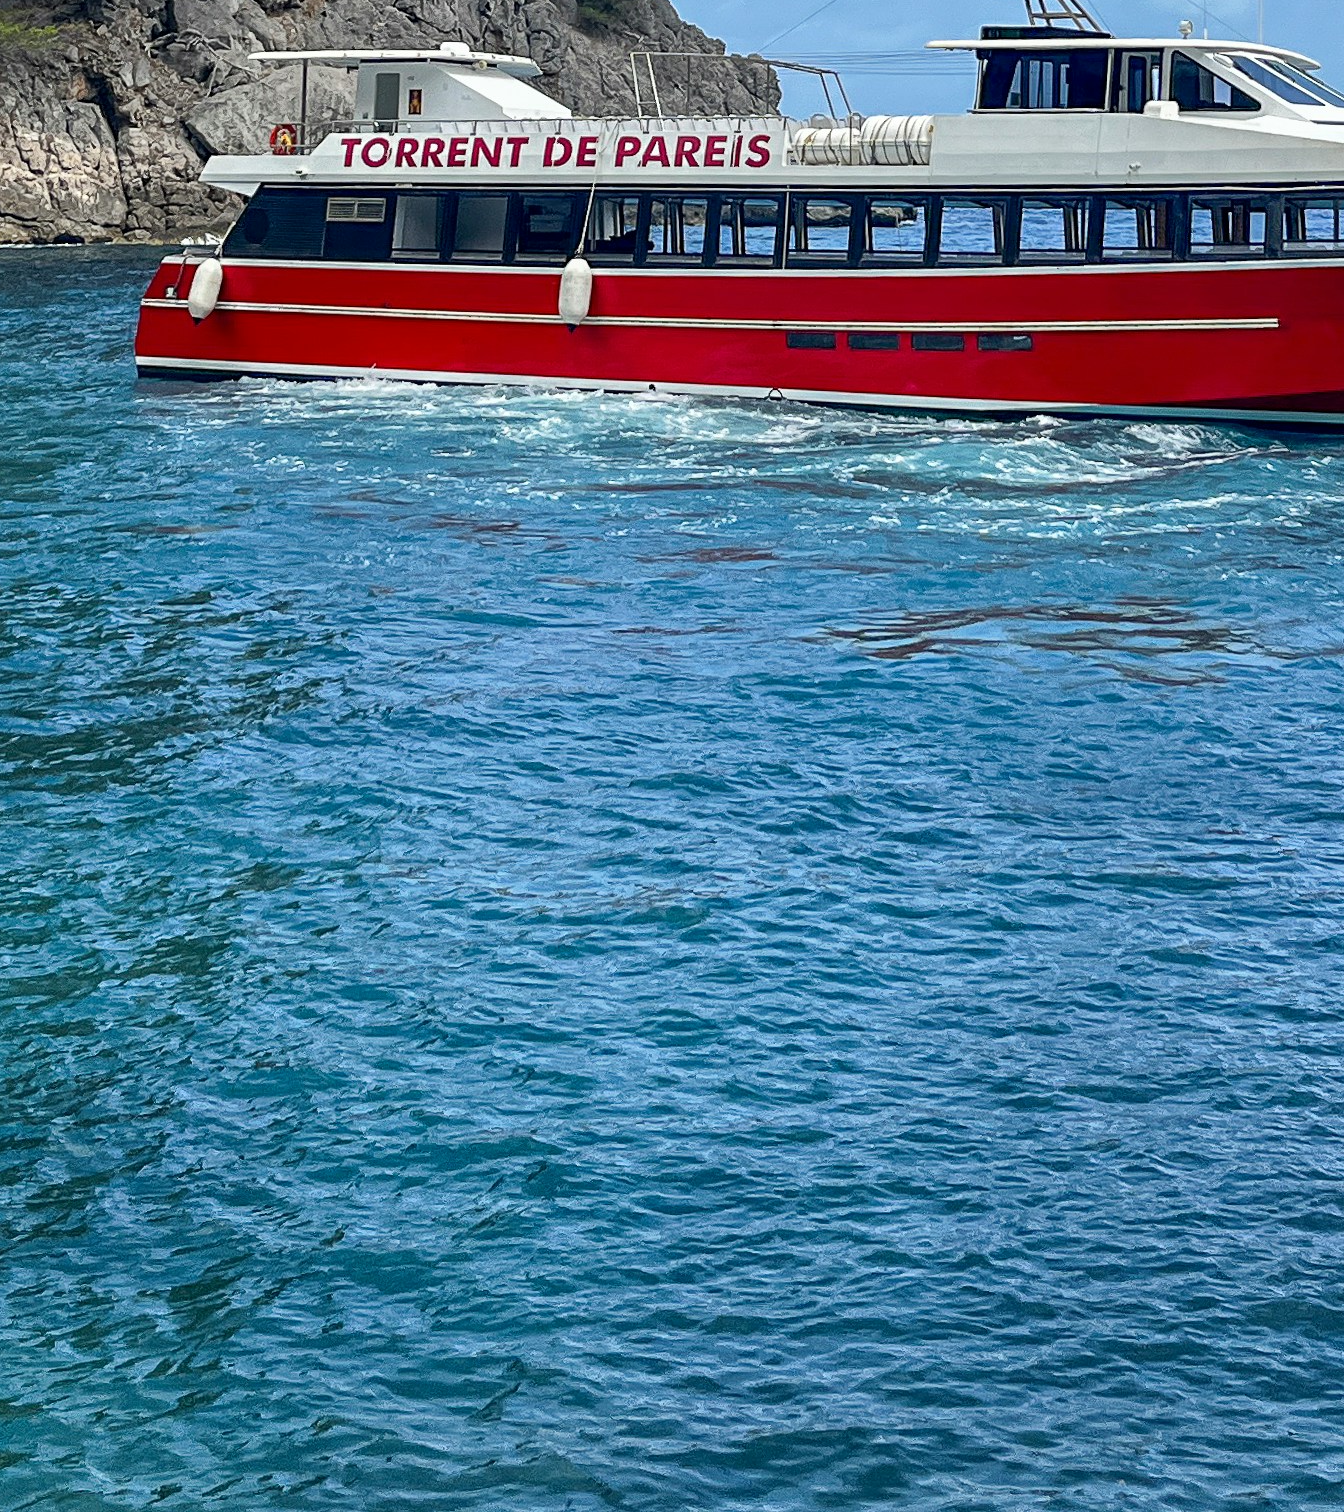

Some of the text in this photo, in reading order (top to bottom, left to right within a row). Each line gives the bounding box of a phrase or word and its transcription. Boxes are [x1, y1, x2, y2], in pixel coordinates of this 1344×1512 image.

[340, 134, 771, 168] TORRENT DE PAREIS
